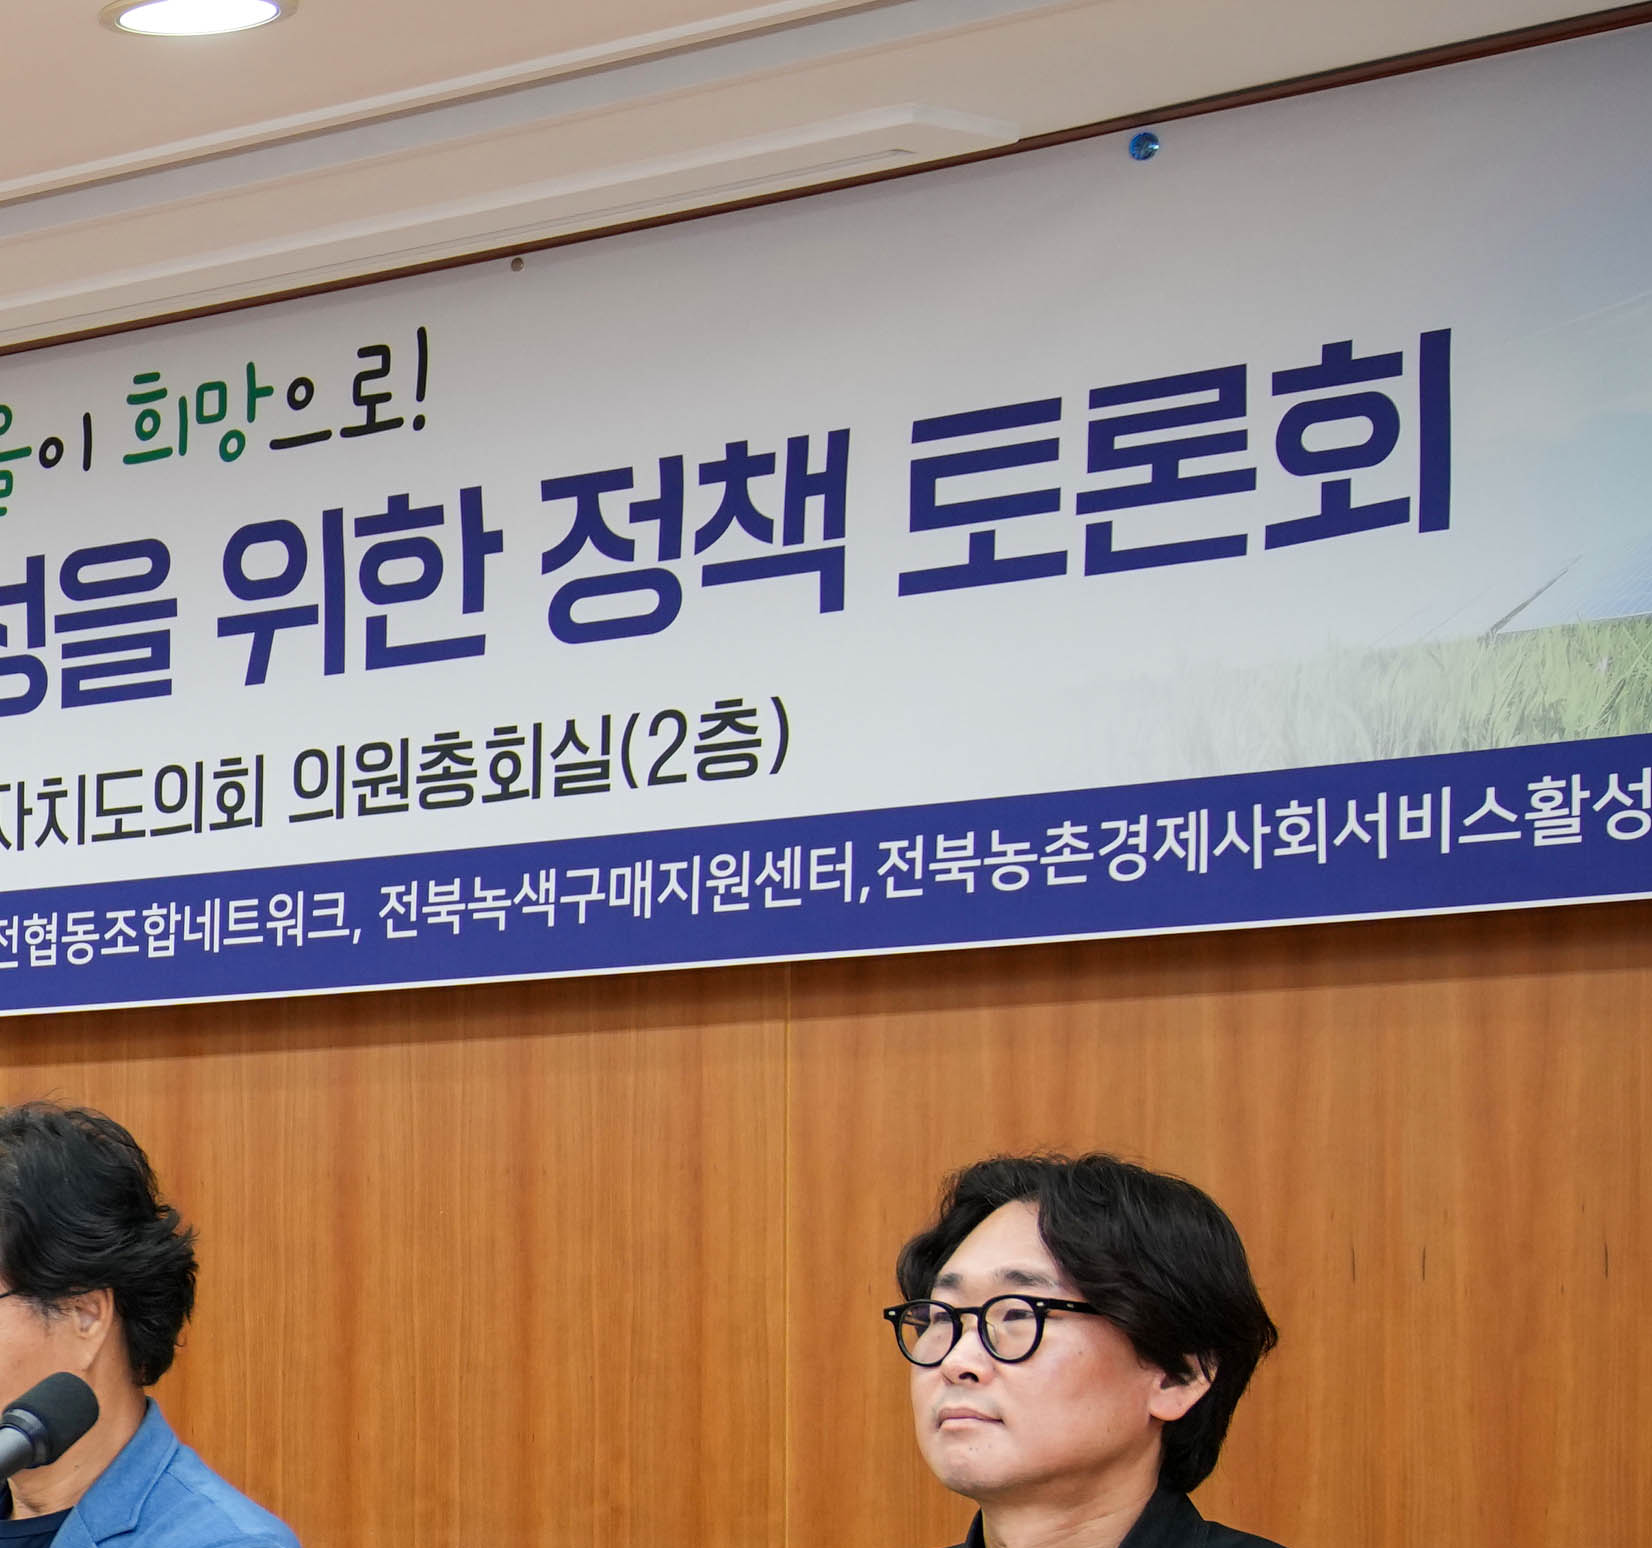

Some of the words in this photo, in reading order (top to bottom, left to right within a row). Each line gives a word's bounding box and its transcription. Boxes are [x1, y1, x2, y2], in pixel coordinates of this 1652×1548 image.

[121, 325, 431, 466] 희망으로!
[216, 486, 505, 688] 위한
[540, 428, 851, 645] 정책
[898, 326, 1453, 596] 토론회
[289, 694, 791, 824] 의원총회실(2층)
